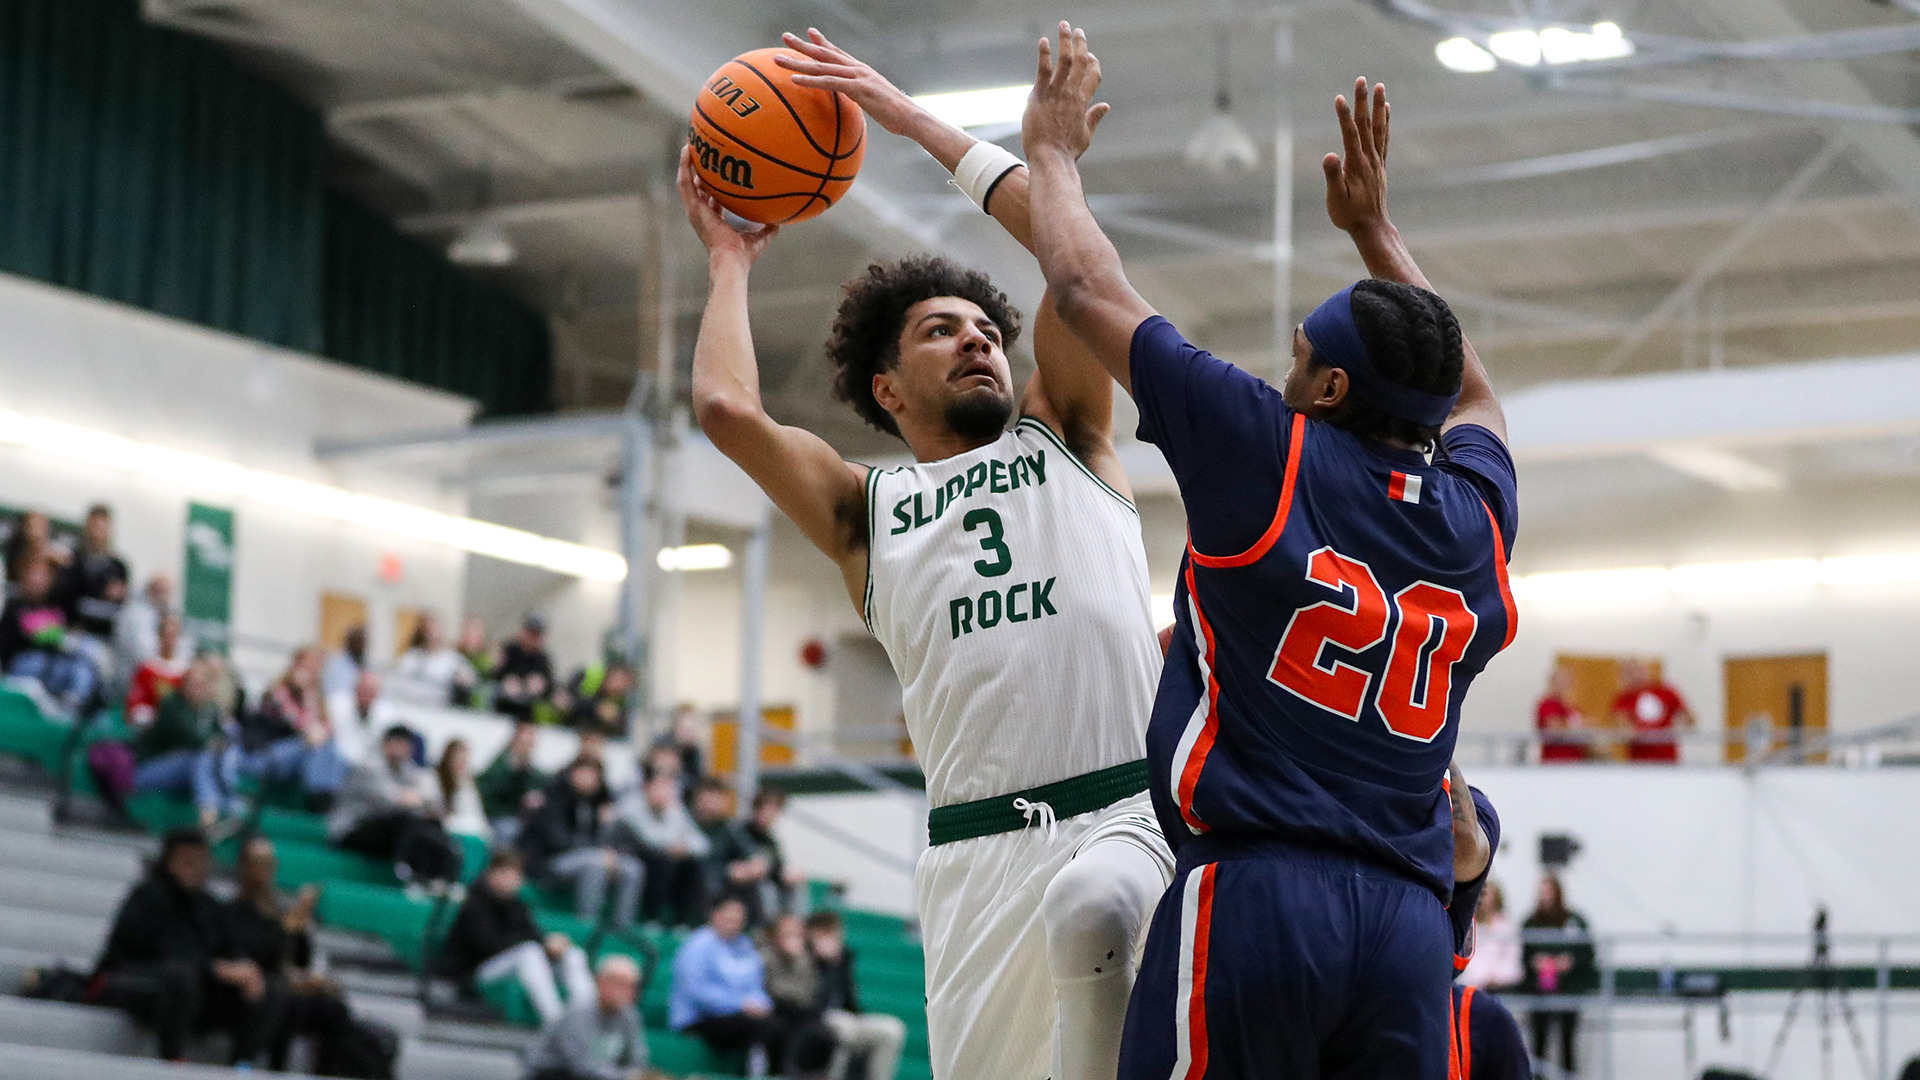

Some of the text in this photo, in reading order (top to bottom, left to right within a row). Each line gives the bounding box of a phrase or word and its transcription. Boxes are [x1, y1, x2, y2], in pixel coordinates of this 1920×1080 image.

[710, 76, 760, 117] EVO
[688, 126, 754, 190] Wilso
[890, 449, 1047, 536] SLIPPERY
[962, 507, 1012, 578] 3
[949, 576, 1058, 640] ROCK
[1265, 545, 1479, 744] 20
